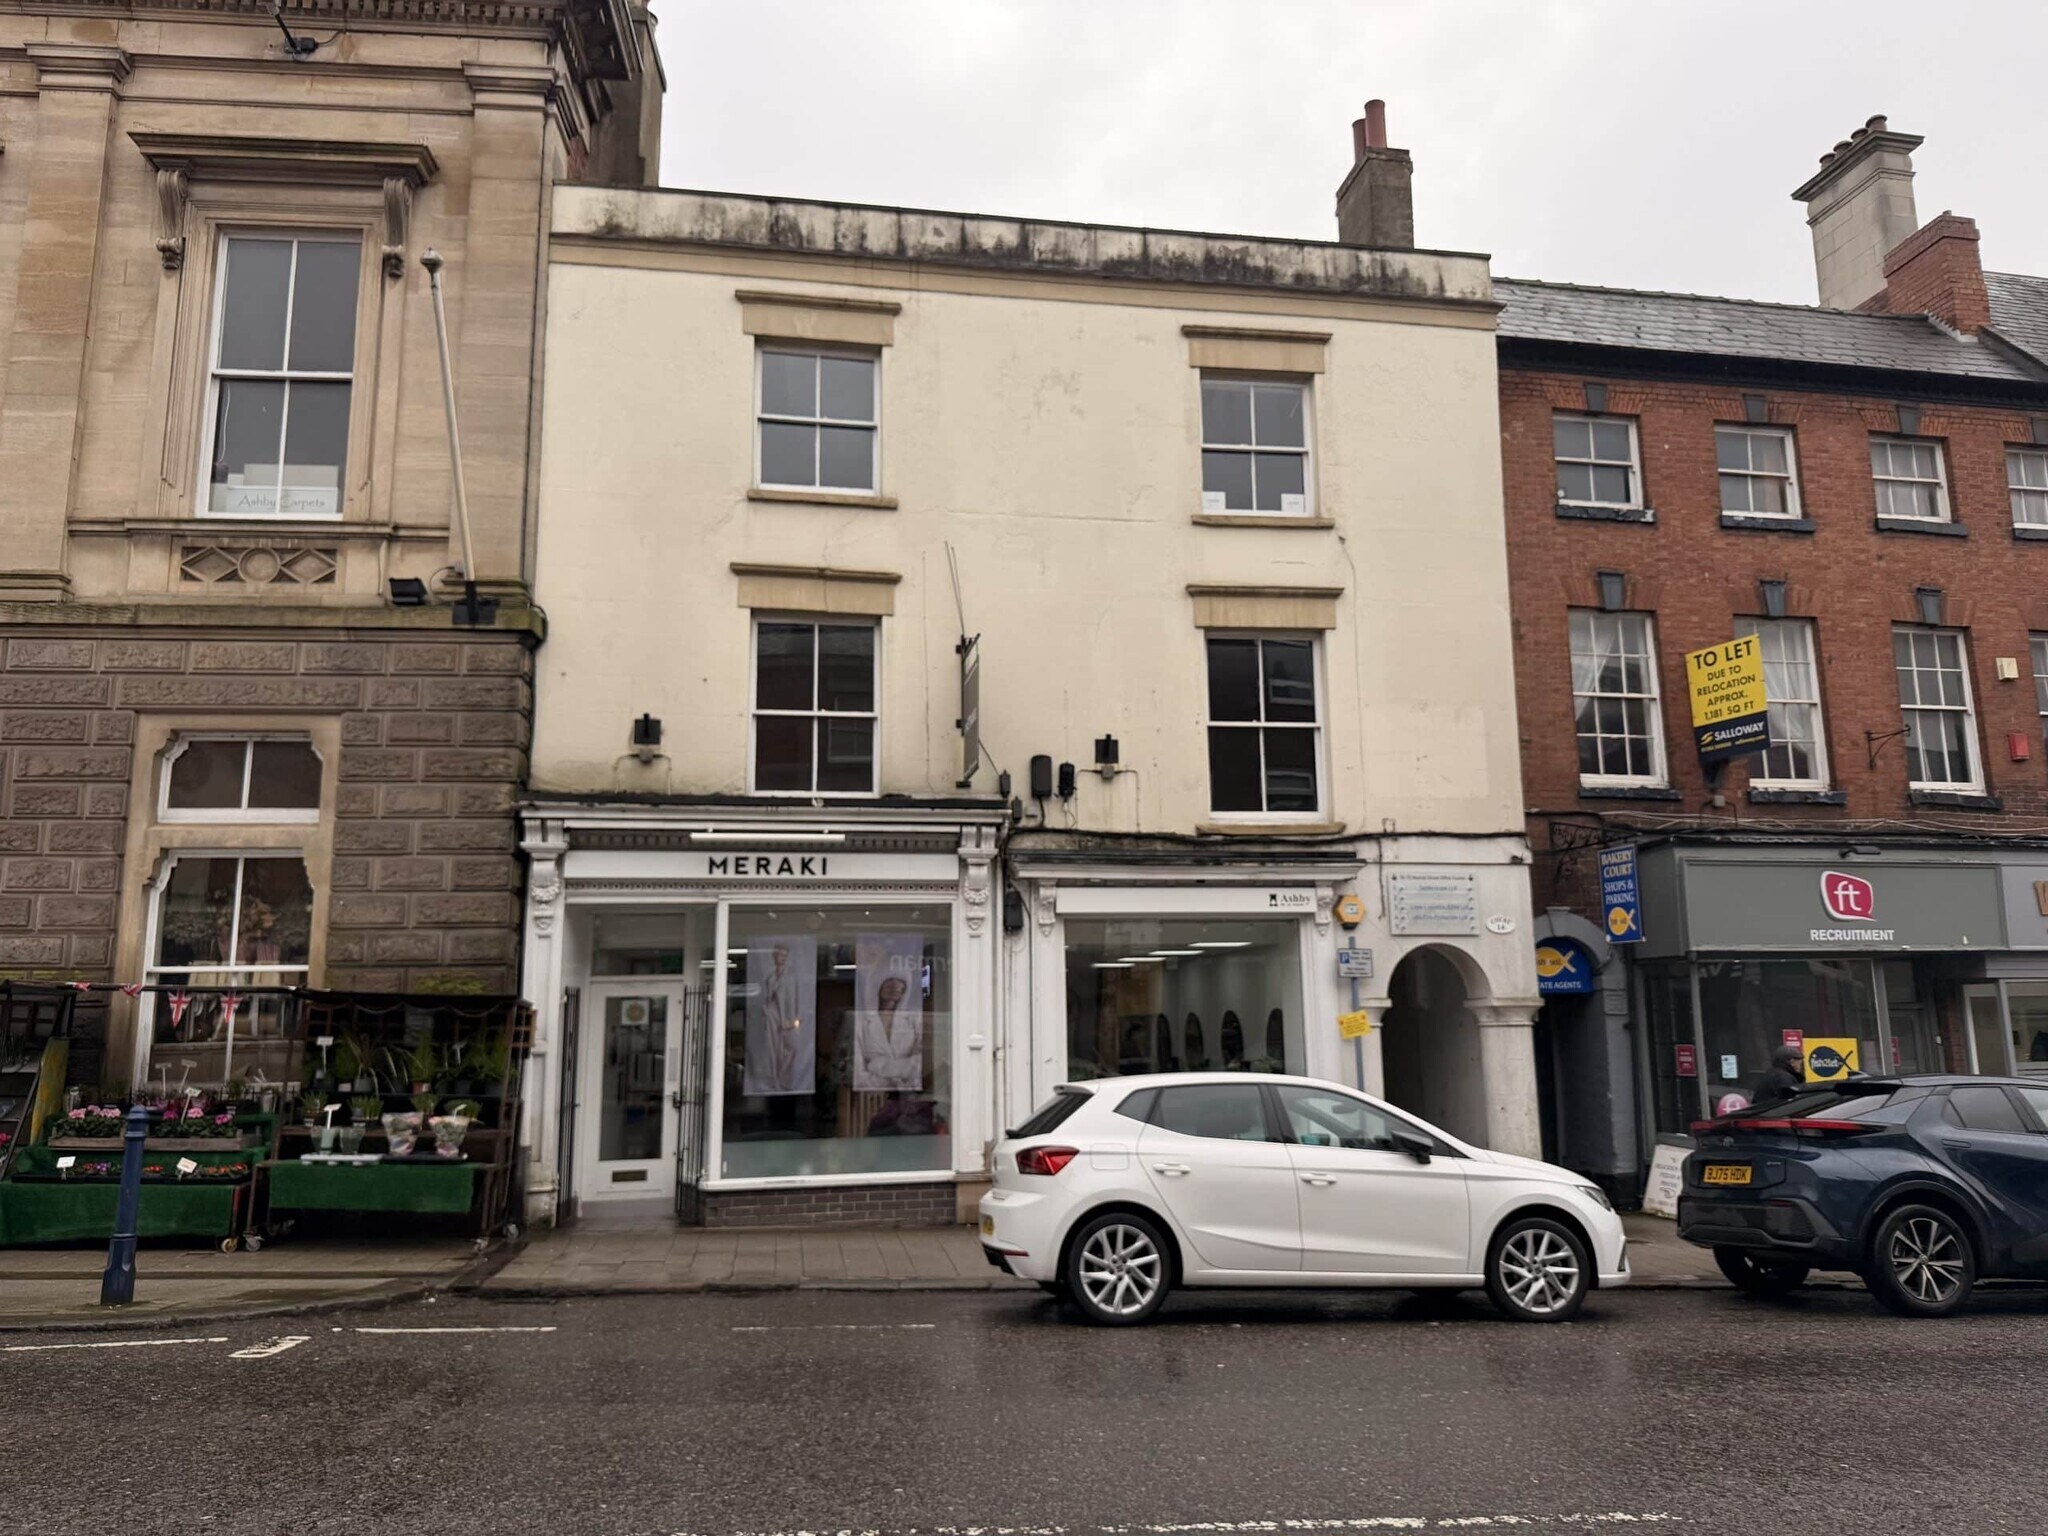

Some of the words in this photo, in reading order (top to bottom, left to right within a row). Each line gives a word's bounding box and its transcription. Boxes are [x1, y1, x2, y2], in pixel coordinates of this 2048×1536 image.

[239, 494, 277, 508] Ashby
[1693, 651, 1717, 669] TO
[1725, 640, 1752, 661] LET
[1707, 668, 1726, 681] DUE
[1728, 665, 1742, 676] TO
[1697, 674, 1756, 696] RELOCATION
[1707, 690, 1748, 707] APPROX.
[1727, 704, 1741, 715] SQ
[1744, 701, 1754, 711] FT
[1714, 721, 1764, 741] SALLOWAY
[1601, 850, 1633, 865] BAKERY
[708, 856, 827, 875] MERAKI
[1603, 863, 1633, 878] COURT
[1604, 880, 1626, 893] SHOPS
[1627, 879, 1634, 889] &
[1281, 894, 1311, 905] Ashby
[1605, 891, 1635, 905] PARKING
[1833, 881, 1862, 911] ft
[1810, 929, 1895, 941] RECRUITMENT
[1554, 981, 1582, 990] AGENTS
